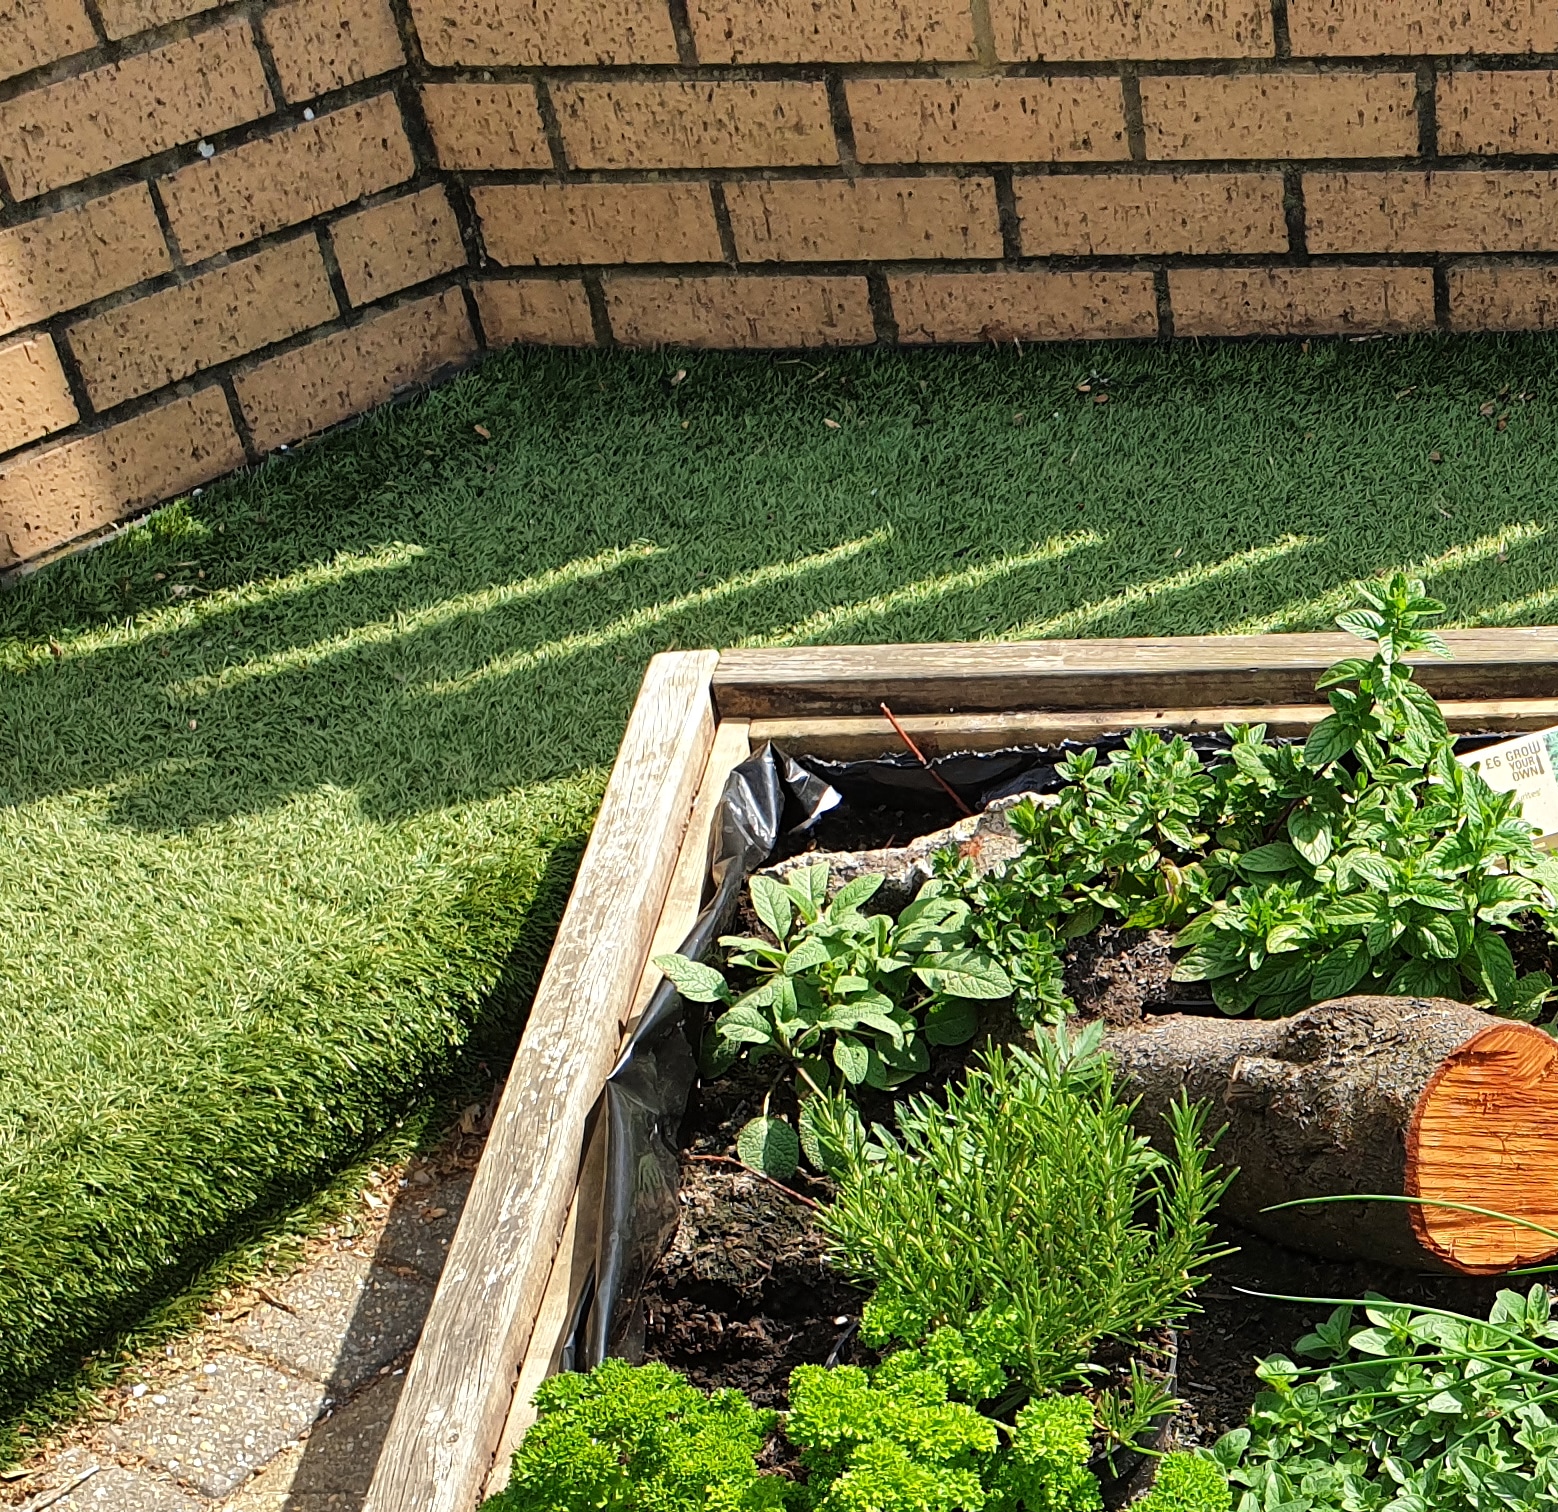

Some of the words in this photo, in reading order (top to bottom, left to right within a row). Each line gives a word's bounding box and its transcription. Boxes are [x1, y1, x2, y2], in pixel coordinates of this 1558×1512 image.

[1506, 740, 1541, 762] GROW
[1509, 755, 1535, 771] YOUR
[1512, 765, 1539, 782] OWN
